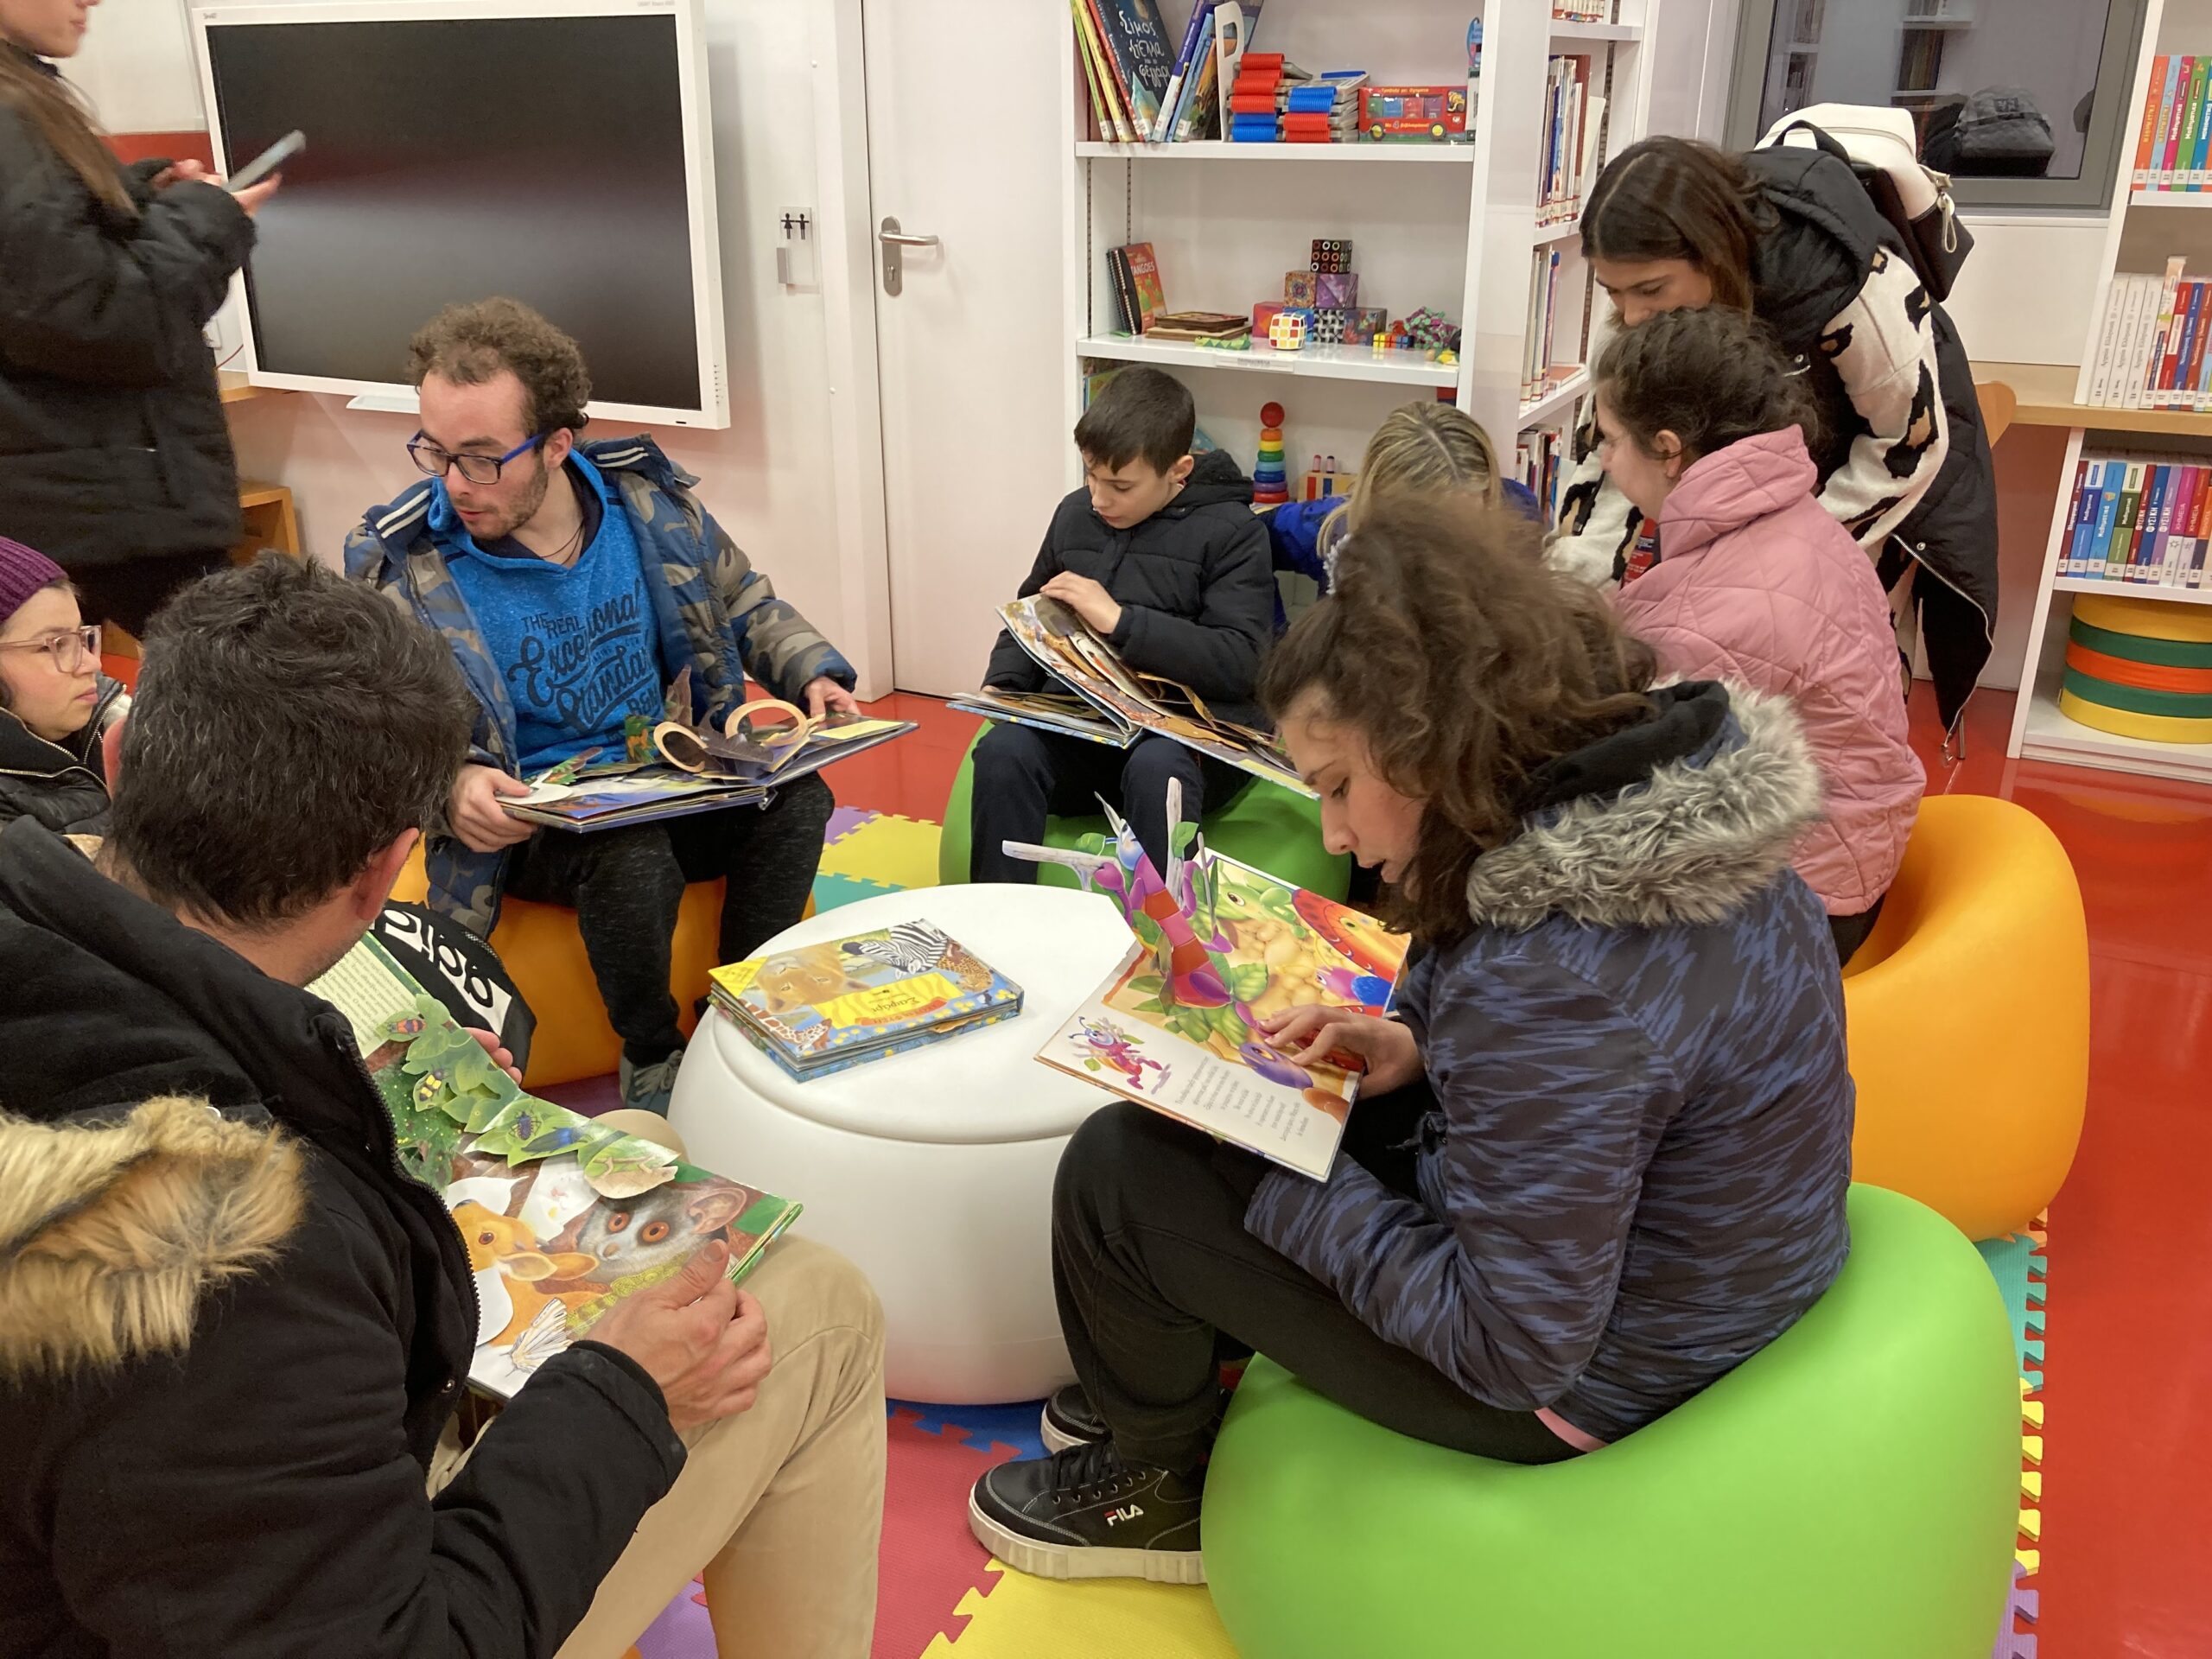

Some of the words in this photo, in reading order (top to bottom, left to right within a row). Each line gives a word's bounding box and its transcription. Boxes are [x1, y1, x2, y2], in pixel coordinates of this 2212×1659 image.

[2146, 507, 2158, 532] ΦΥΣΙΚΗ
[521, 612, 549, 632] THE
[545, 615, 586, 639] REAL
[1104, 1503, 1144, 1527] FILA
